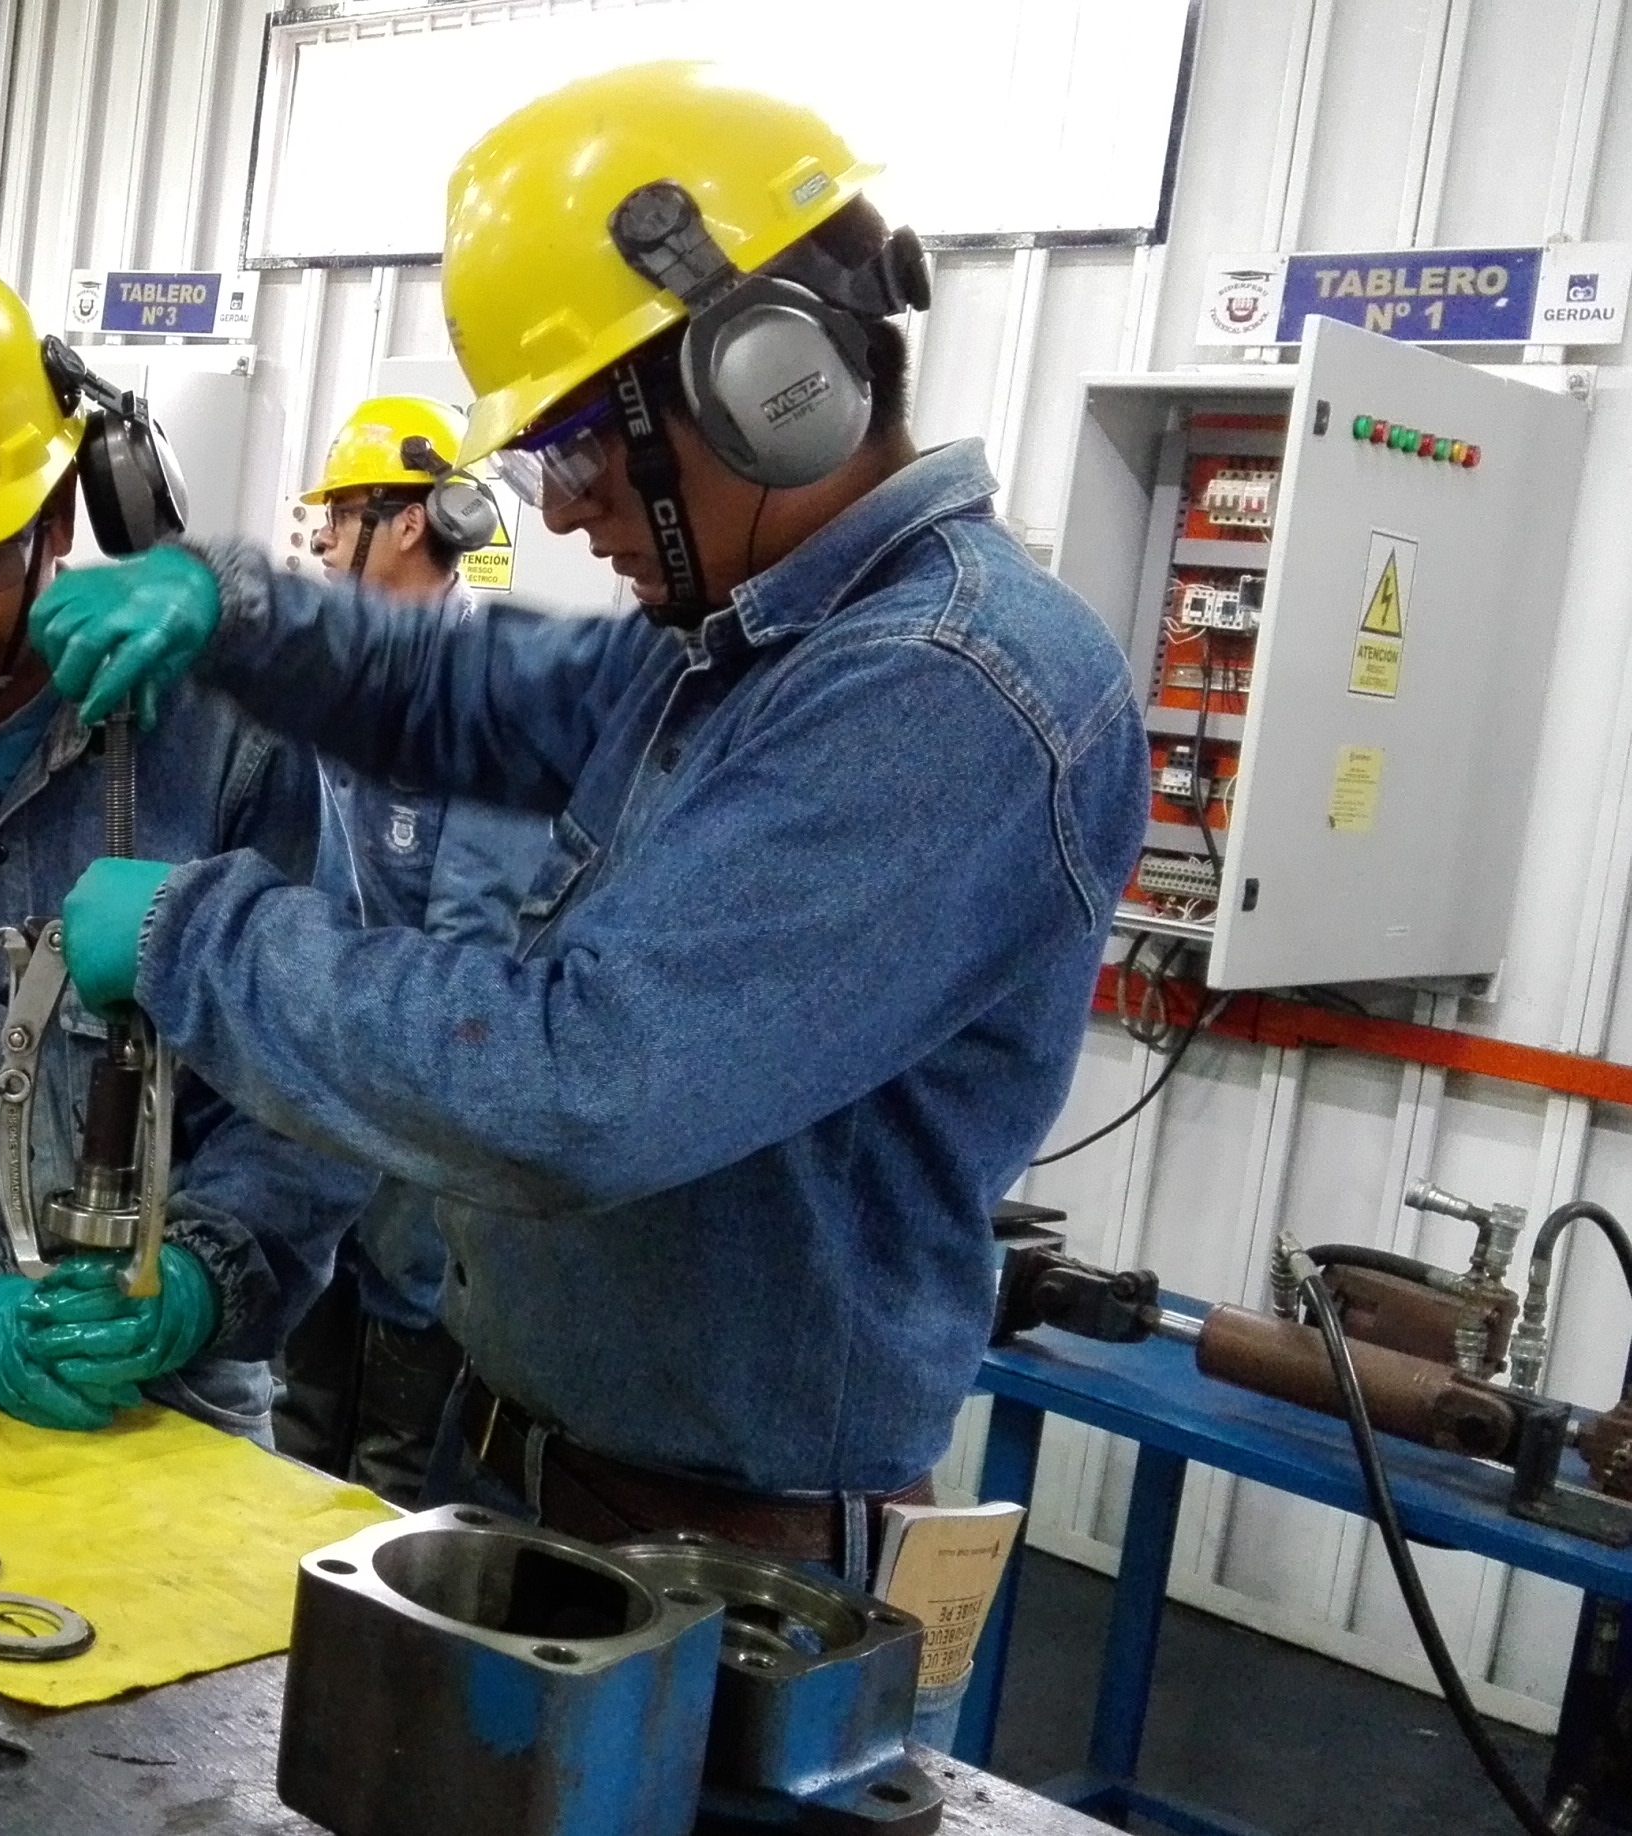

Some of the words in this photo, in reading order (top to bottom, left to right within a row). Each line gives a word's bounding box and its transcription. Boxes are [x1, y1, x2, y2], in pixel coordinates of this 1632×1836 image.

[1315, 265, 1508, 297] TABLERO
[120, 283, 207, 304] TABLERO
[165, 306, 177, 326] 3
[220, 314, 250, 322] GERDAU
[1425, 301, 1443, 330] 1
[1544, 307, 1615, 321] GERDAU
[764, 376, 827, 420] MSA
[463, 553, 509, 566] TENCIÓN
[468, 566, 493, 574] RIESGO
